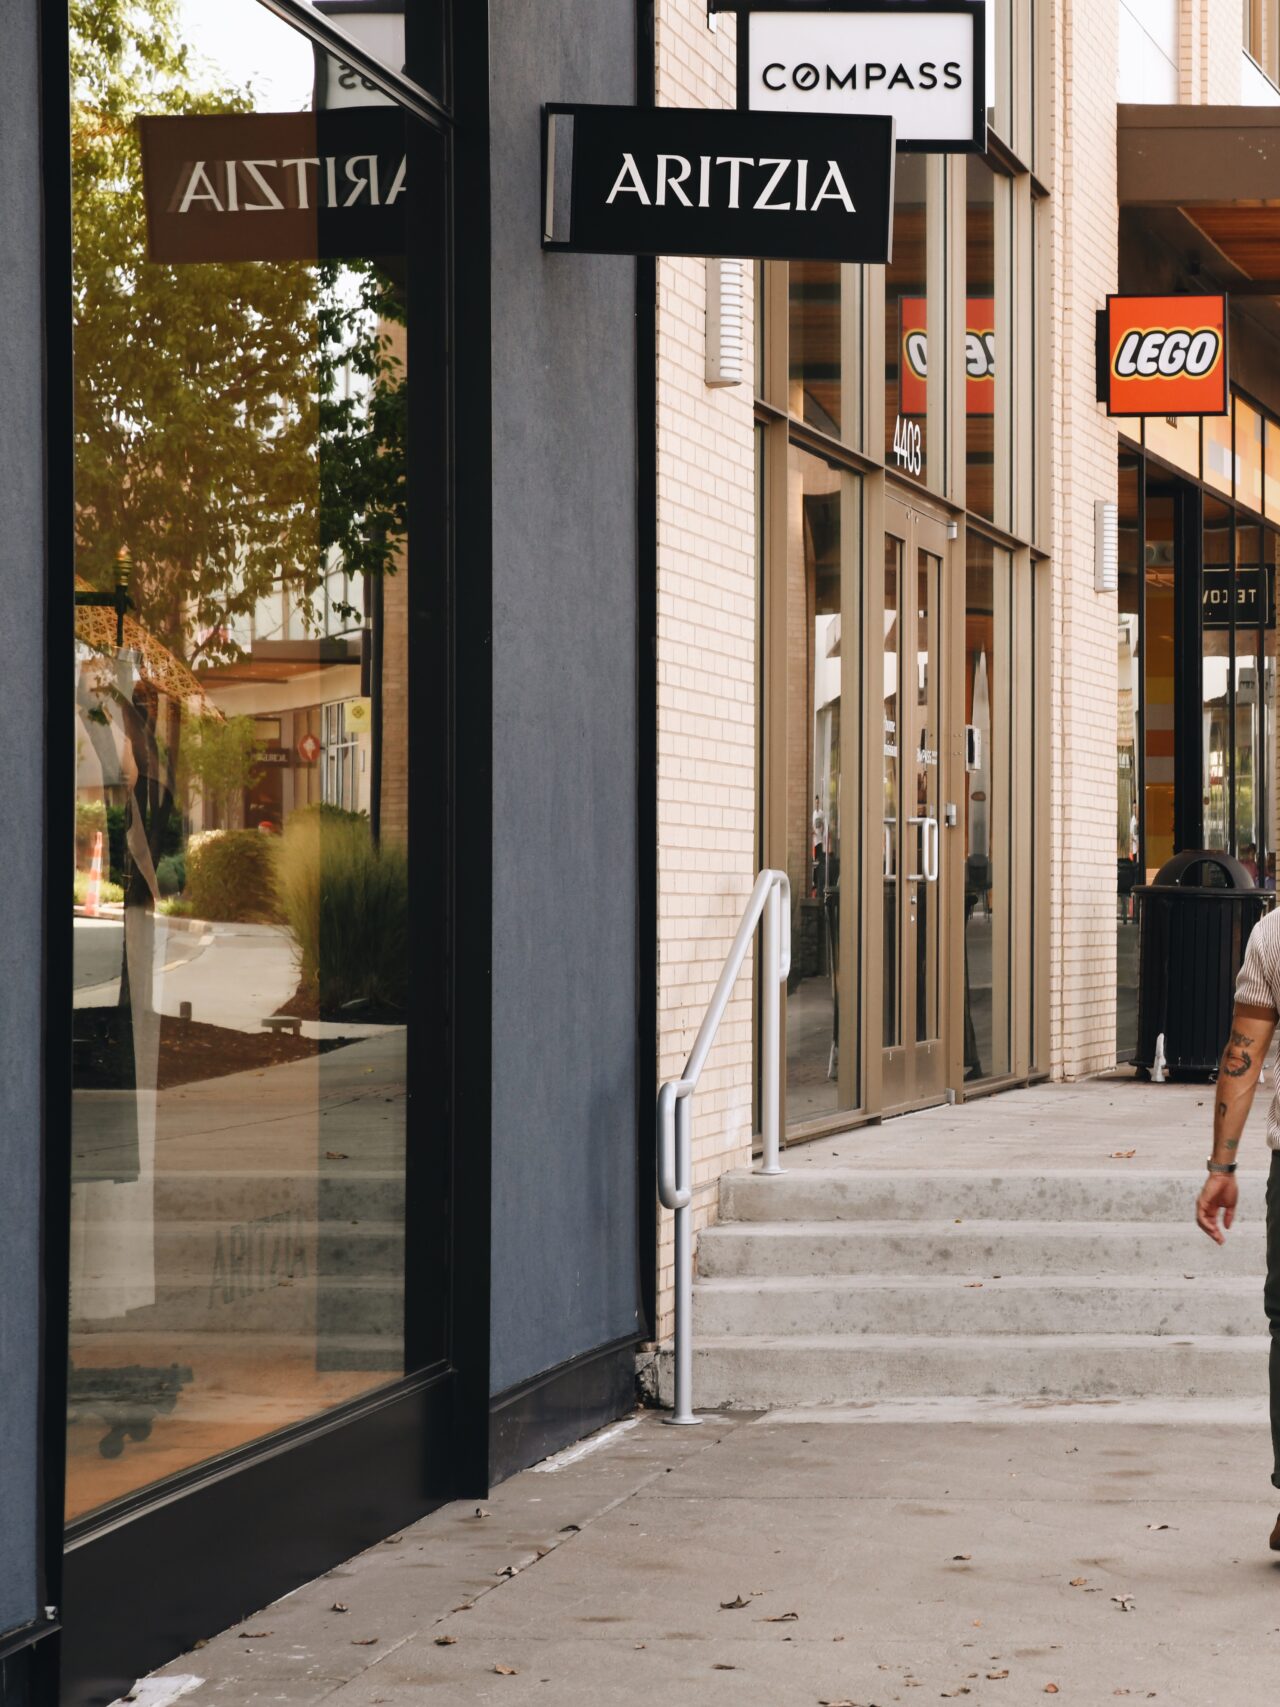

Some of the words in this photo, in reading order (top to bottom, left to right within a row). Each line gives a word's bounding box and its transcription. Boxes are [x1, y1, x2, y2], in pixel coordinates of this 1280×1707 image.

[761, 62, 963, 91] COMPASS
[605, 152, 857, 213] ARITZIA
[1115, 330, 1220, 377] LEGO
[893, 414, 921, 477] 4403
